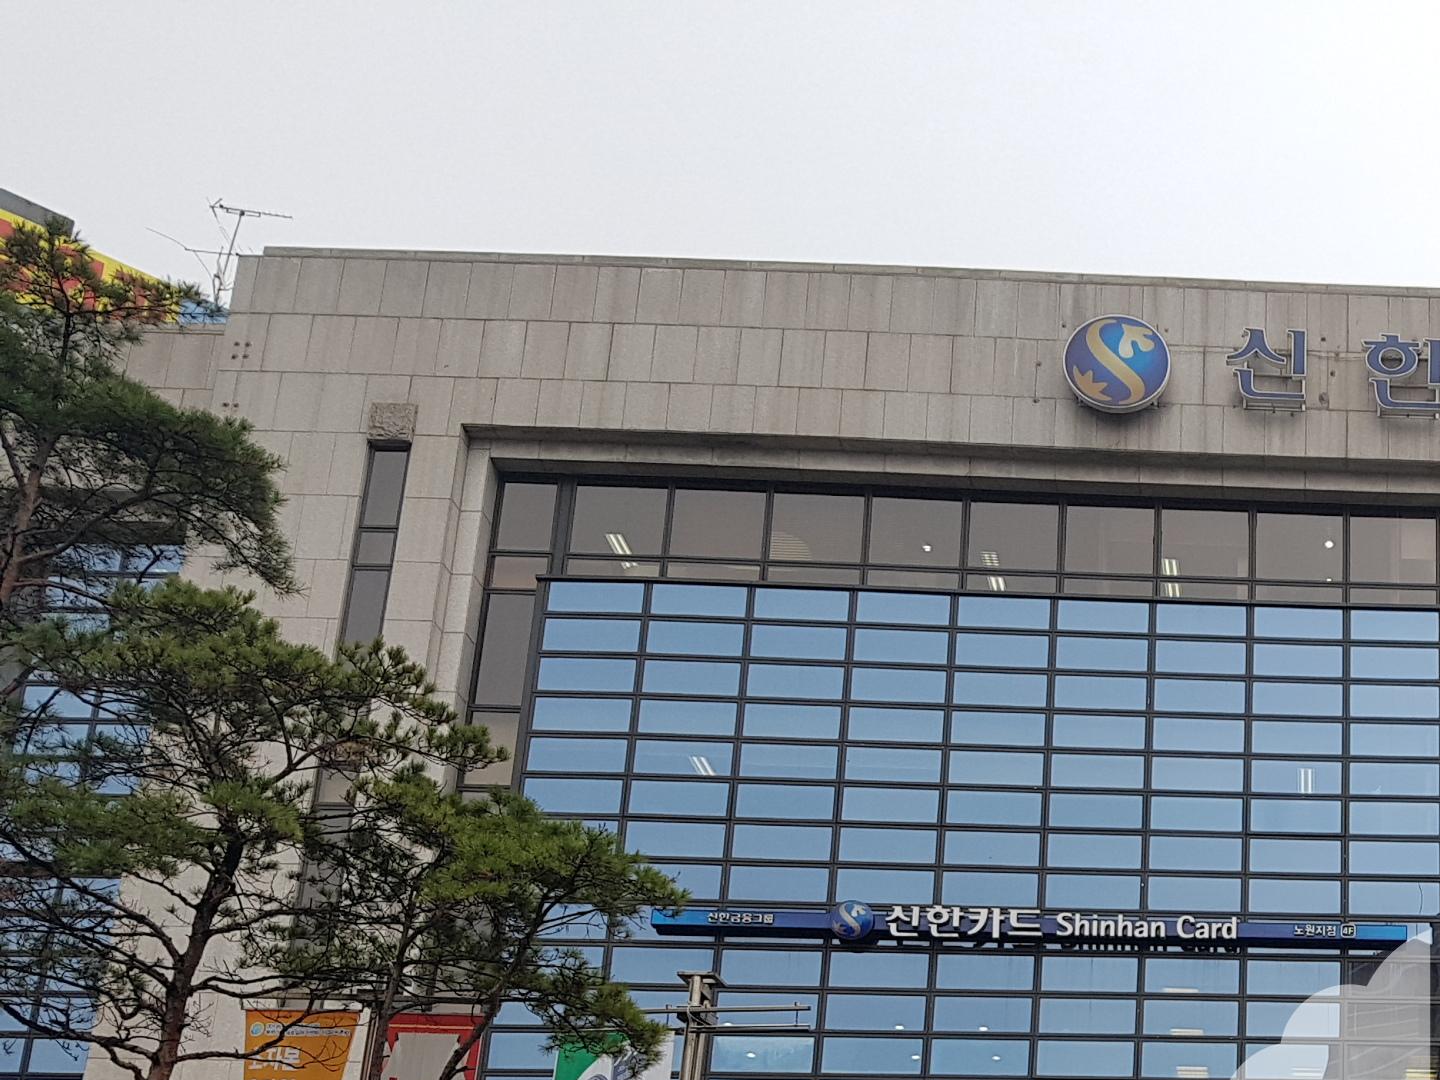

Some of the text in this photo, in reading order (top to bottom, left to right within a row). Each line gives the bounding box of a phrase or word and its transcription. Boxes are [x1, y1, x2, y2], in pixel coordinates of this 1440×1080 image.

[707, 911, 774, 925] 신한금융그룹
[885, 905, 1043, 939] 신한카드
[1056, 912, 1238, 941] Shinhan Card
[1293, 923, 1337, 938] 노원지점
